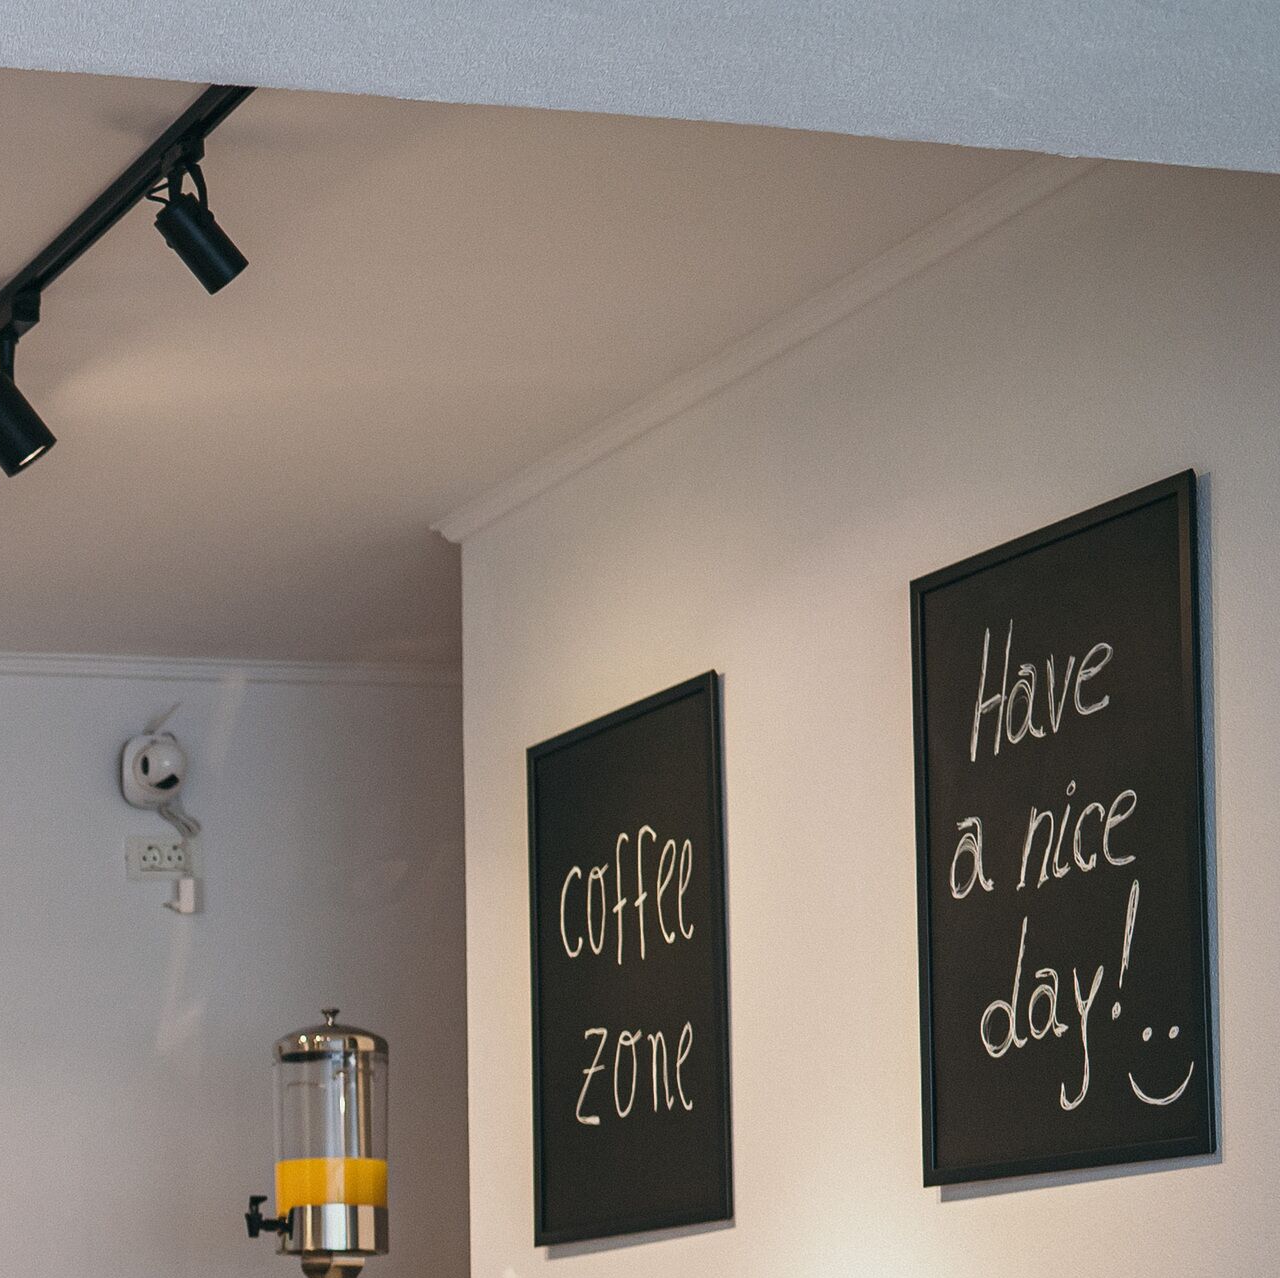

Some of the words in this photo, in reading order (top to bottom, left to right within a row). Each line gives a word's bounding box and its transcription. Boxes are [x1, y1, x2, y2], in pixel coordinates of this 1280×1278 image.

[970, 618, 1113, 763] Have
[560, 824, 695, 966] coffee
[949, 816, 995, 900] a
[1016, 779, 1138, 891] nice
[980, 879, 1140, 1111] day!
[575, 1021, 693, 1126] zone
